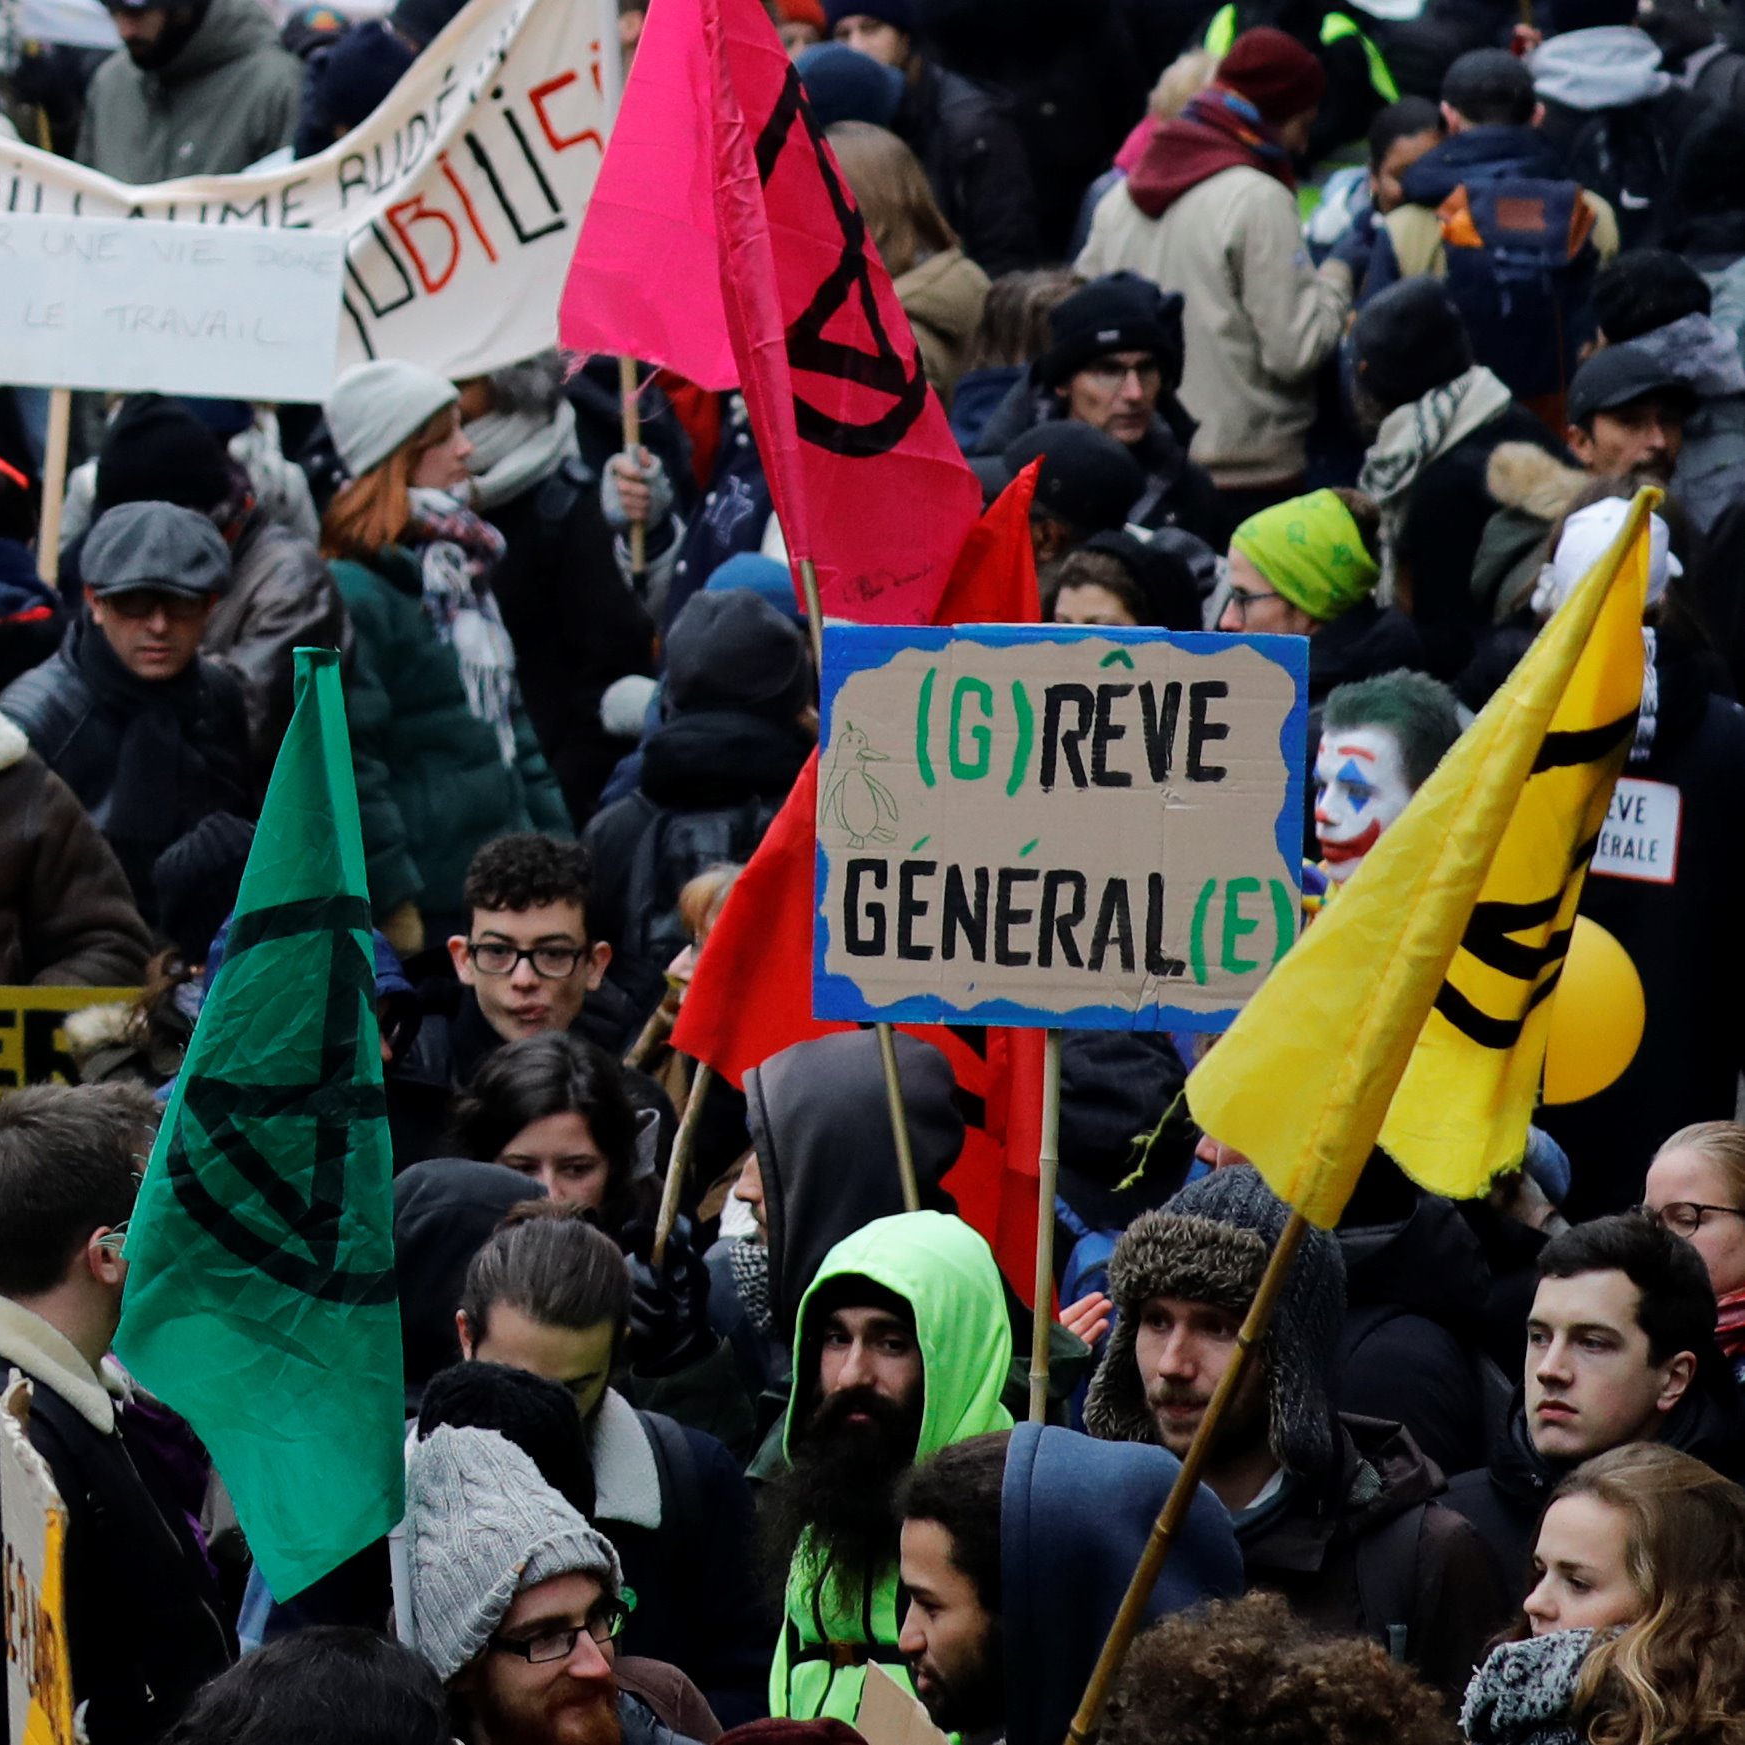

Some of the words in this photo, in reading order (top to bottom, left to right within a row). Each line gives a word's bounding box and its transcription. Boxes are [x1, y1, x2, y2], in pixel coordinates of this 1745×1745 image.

[103, 302, 289, 345] TRAVAIL
[916, 649, 1231, 797] (G)RÊVE
[844, 835, 1296, 985] GÉNÉRAL(E)
